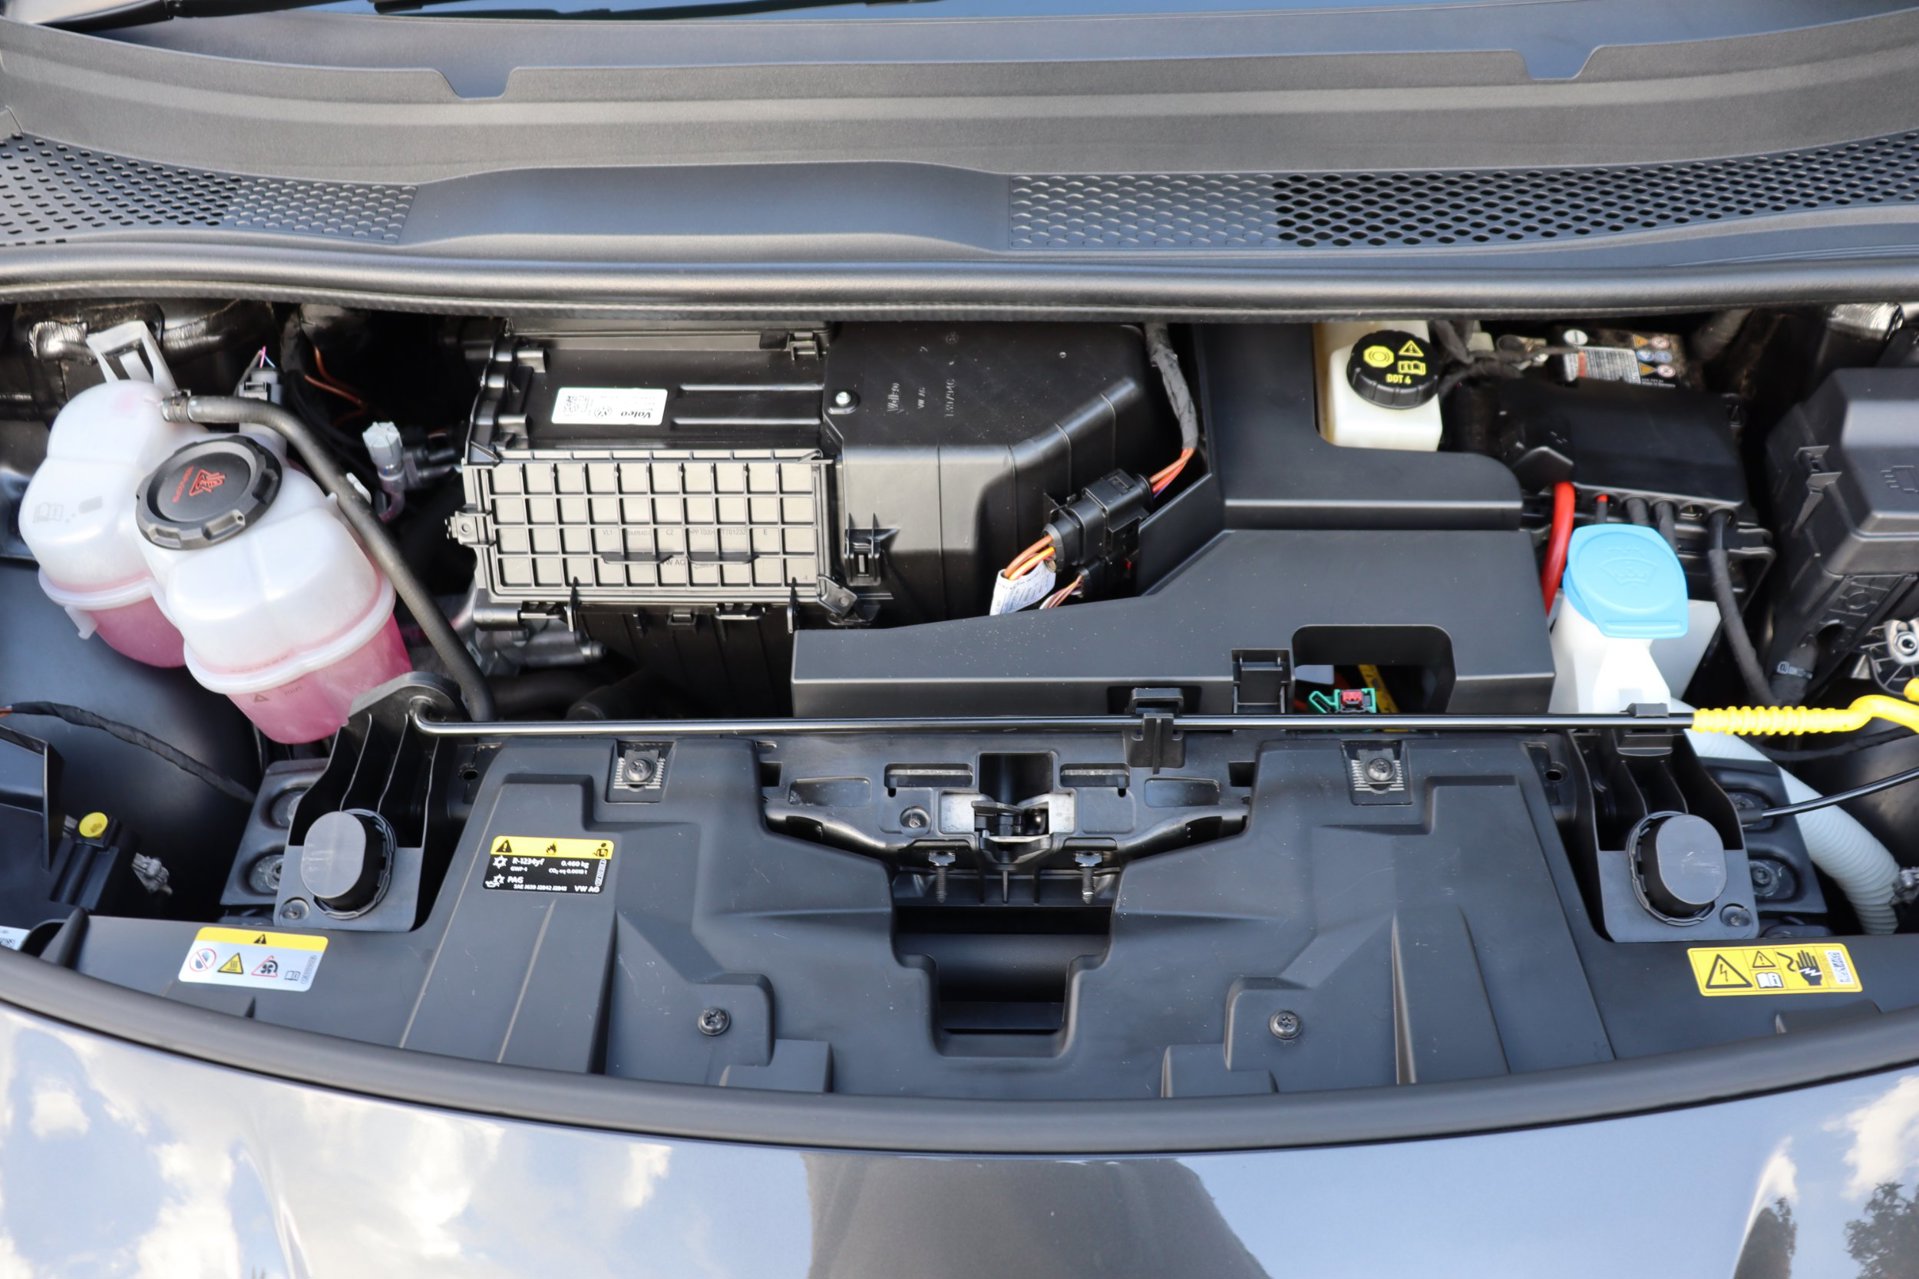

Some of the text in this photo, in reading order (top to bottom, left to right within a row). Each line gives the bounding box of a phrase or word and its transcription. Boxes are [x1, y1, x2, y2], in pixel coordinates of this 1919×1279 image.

[1385, 373, 1412, 385] DOT 4
[620, 411, 652, 419] Valeo
[512, 857, 545, 867] R-1234yf
[581, 861, 590, 869] kg
[507, 876, 524, 884] PAG
